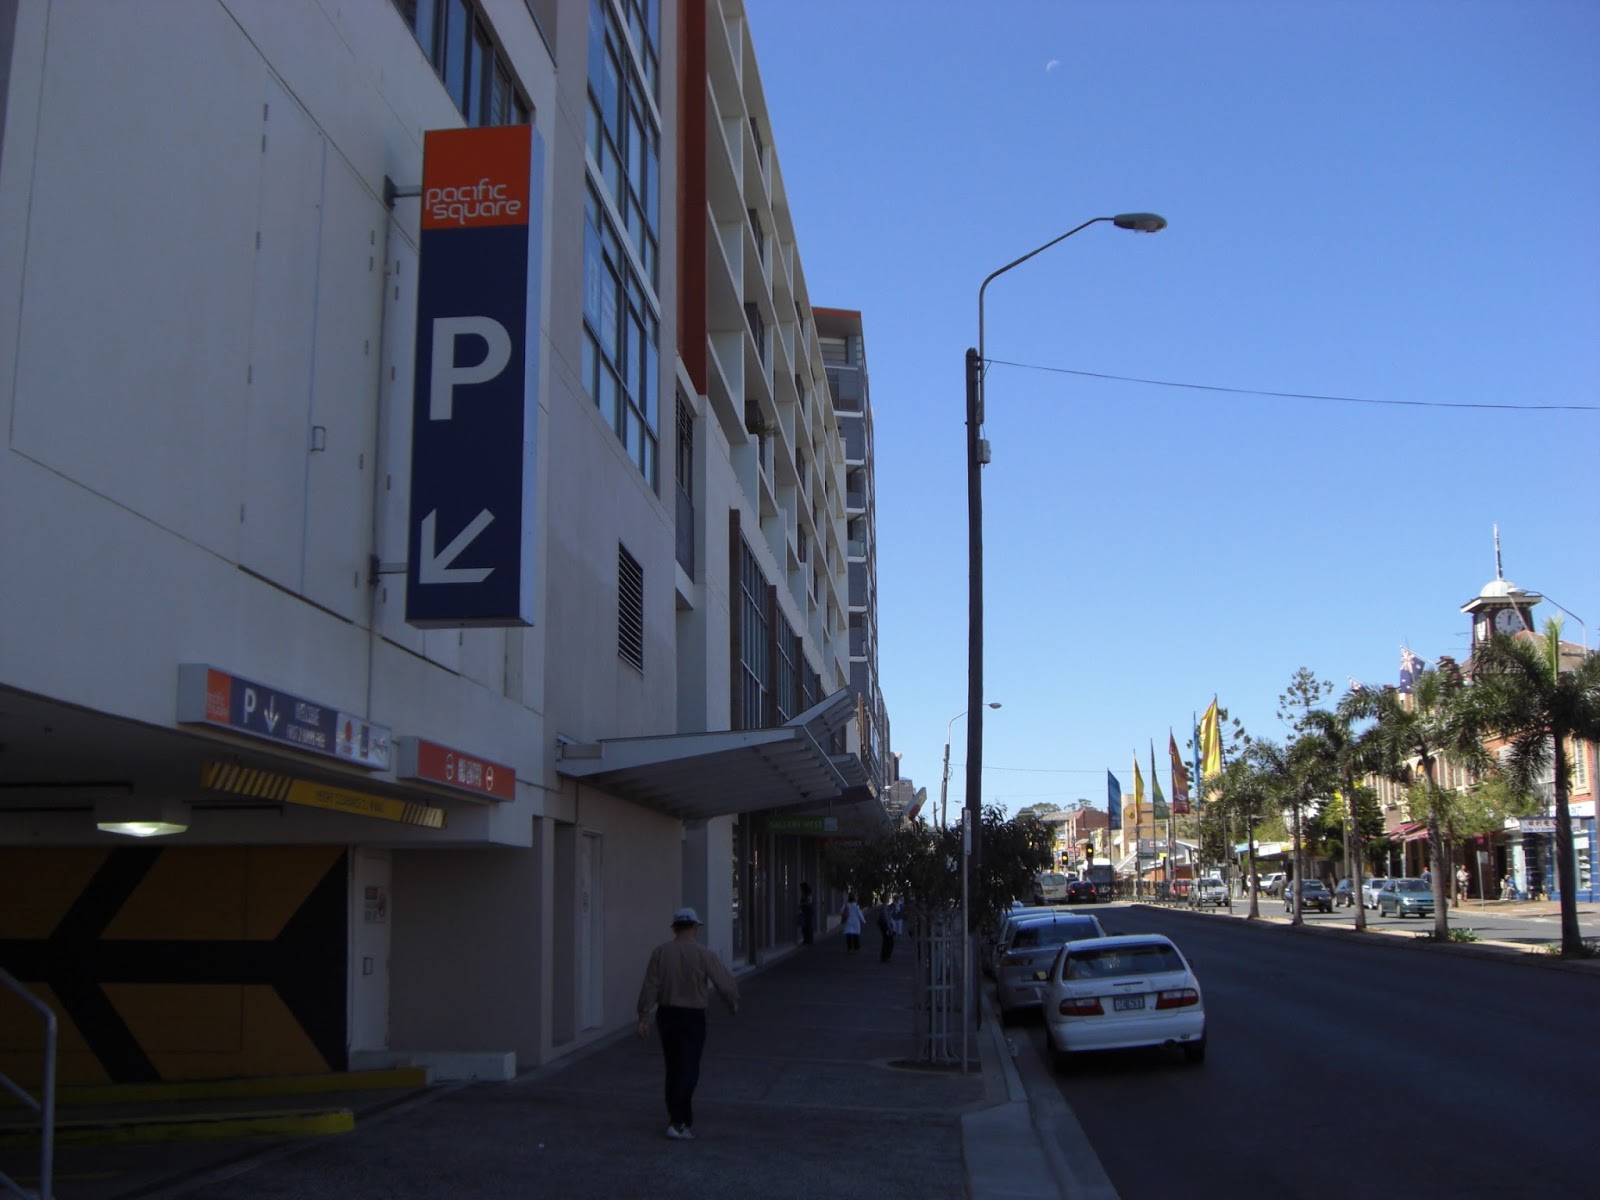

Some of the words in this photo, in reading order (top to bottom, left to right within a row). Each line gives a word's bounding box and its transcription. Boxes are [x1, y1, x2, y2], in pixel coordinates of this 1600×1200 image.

[425, 178, 507, 210] pacific
[433, 200, 522, 225] square
[429, 316, 512, 420] P
[244, 687, 256, 724] P
